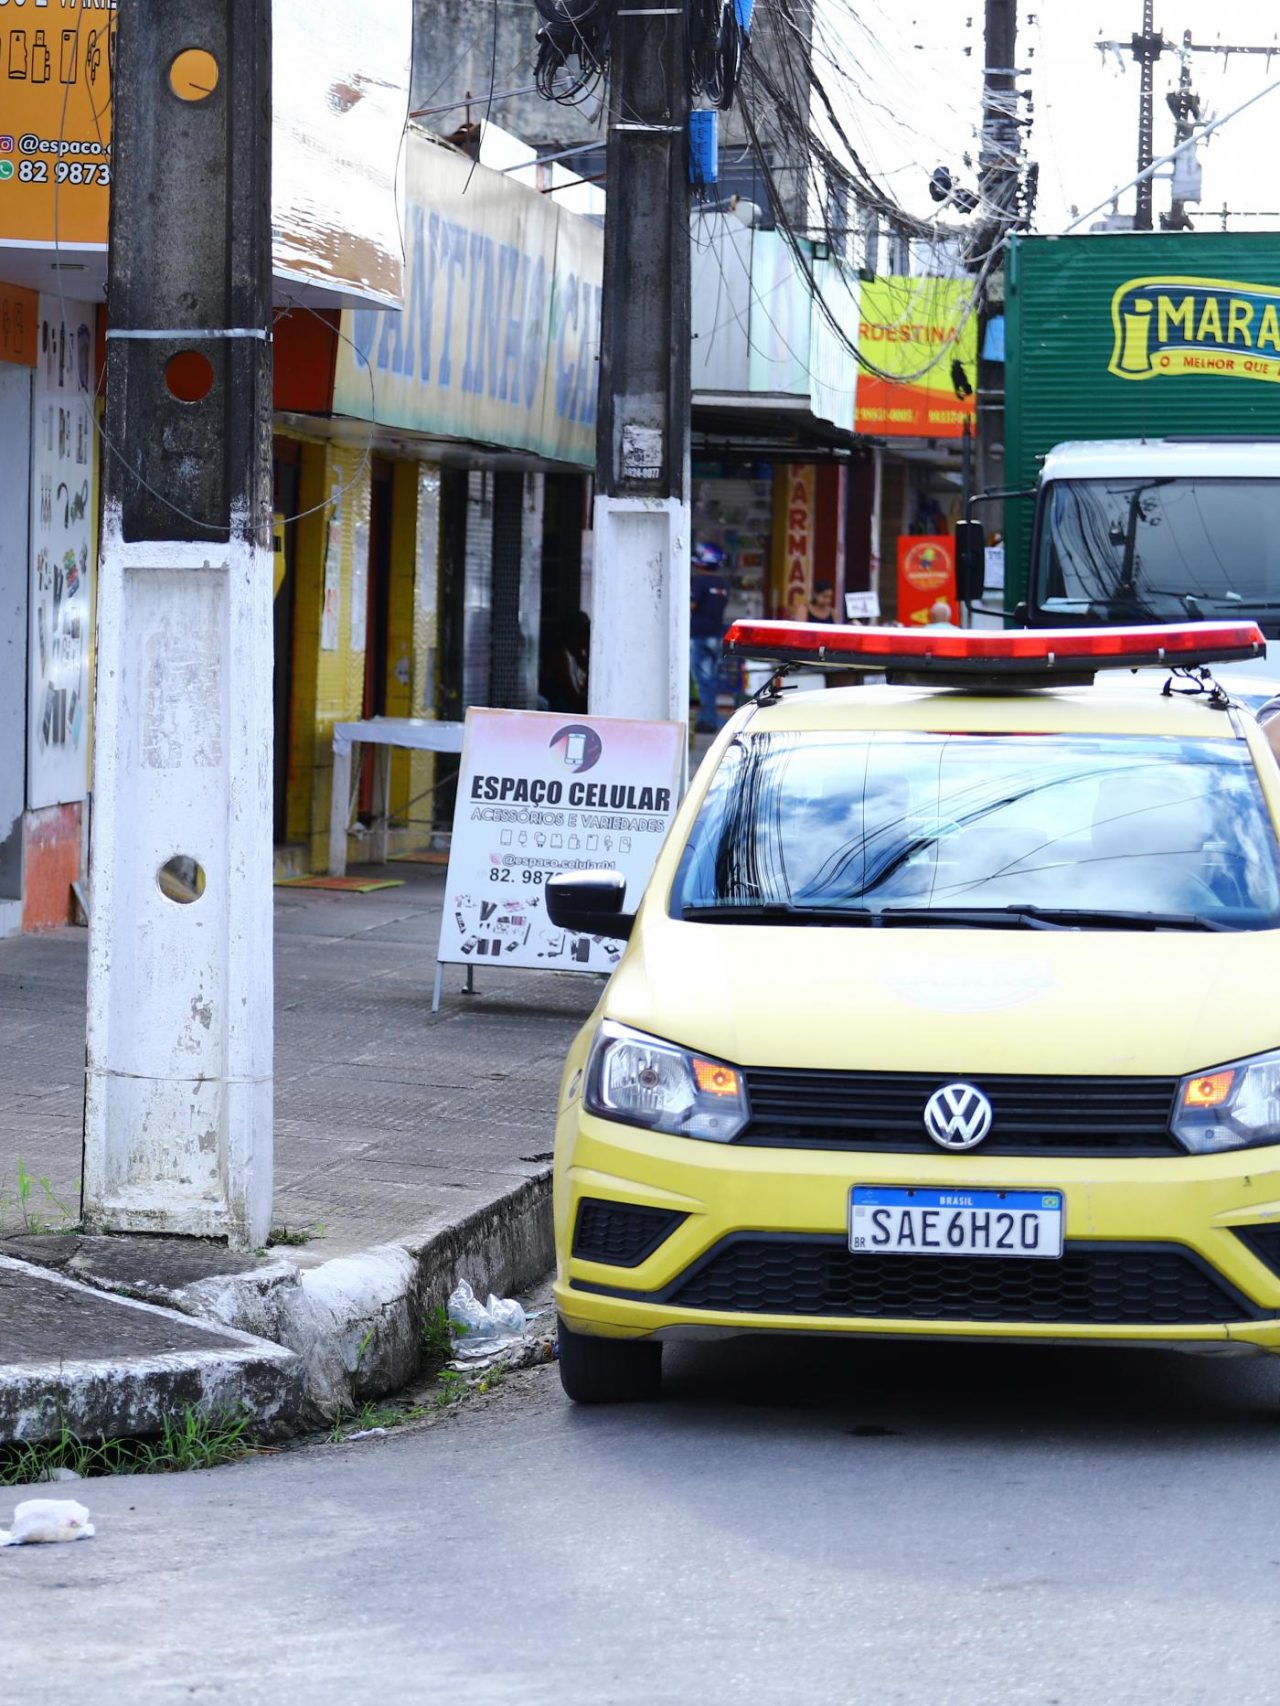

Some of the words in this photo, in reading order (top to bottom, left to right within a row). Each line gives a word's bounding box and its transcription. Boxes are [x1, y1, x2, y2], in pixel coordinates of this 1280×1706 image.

[19, 160, 48, 183] 82
[54, 162, 111, 186] 9873
[1160, 355, 1171, 368] O
[1183, 356, 1235, 370] MELHOR
[1243, 360, 1269, 374] QUE
[471, 775, 562, 807] ESPAÇO
[568, 782, 671, 812] CELULAR
[470, 806, 564, 827] ACESSÓRIOS
[567, 813, 578, 828] E
[581, 814, 665, 833] VARIEDADES
[939, 1196, 973, 1206] BRASIL
[871, 1208, 1039, 1249] SAE6H20
[854, 1236, 866, 1248] BR
